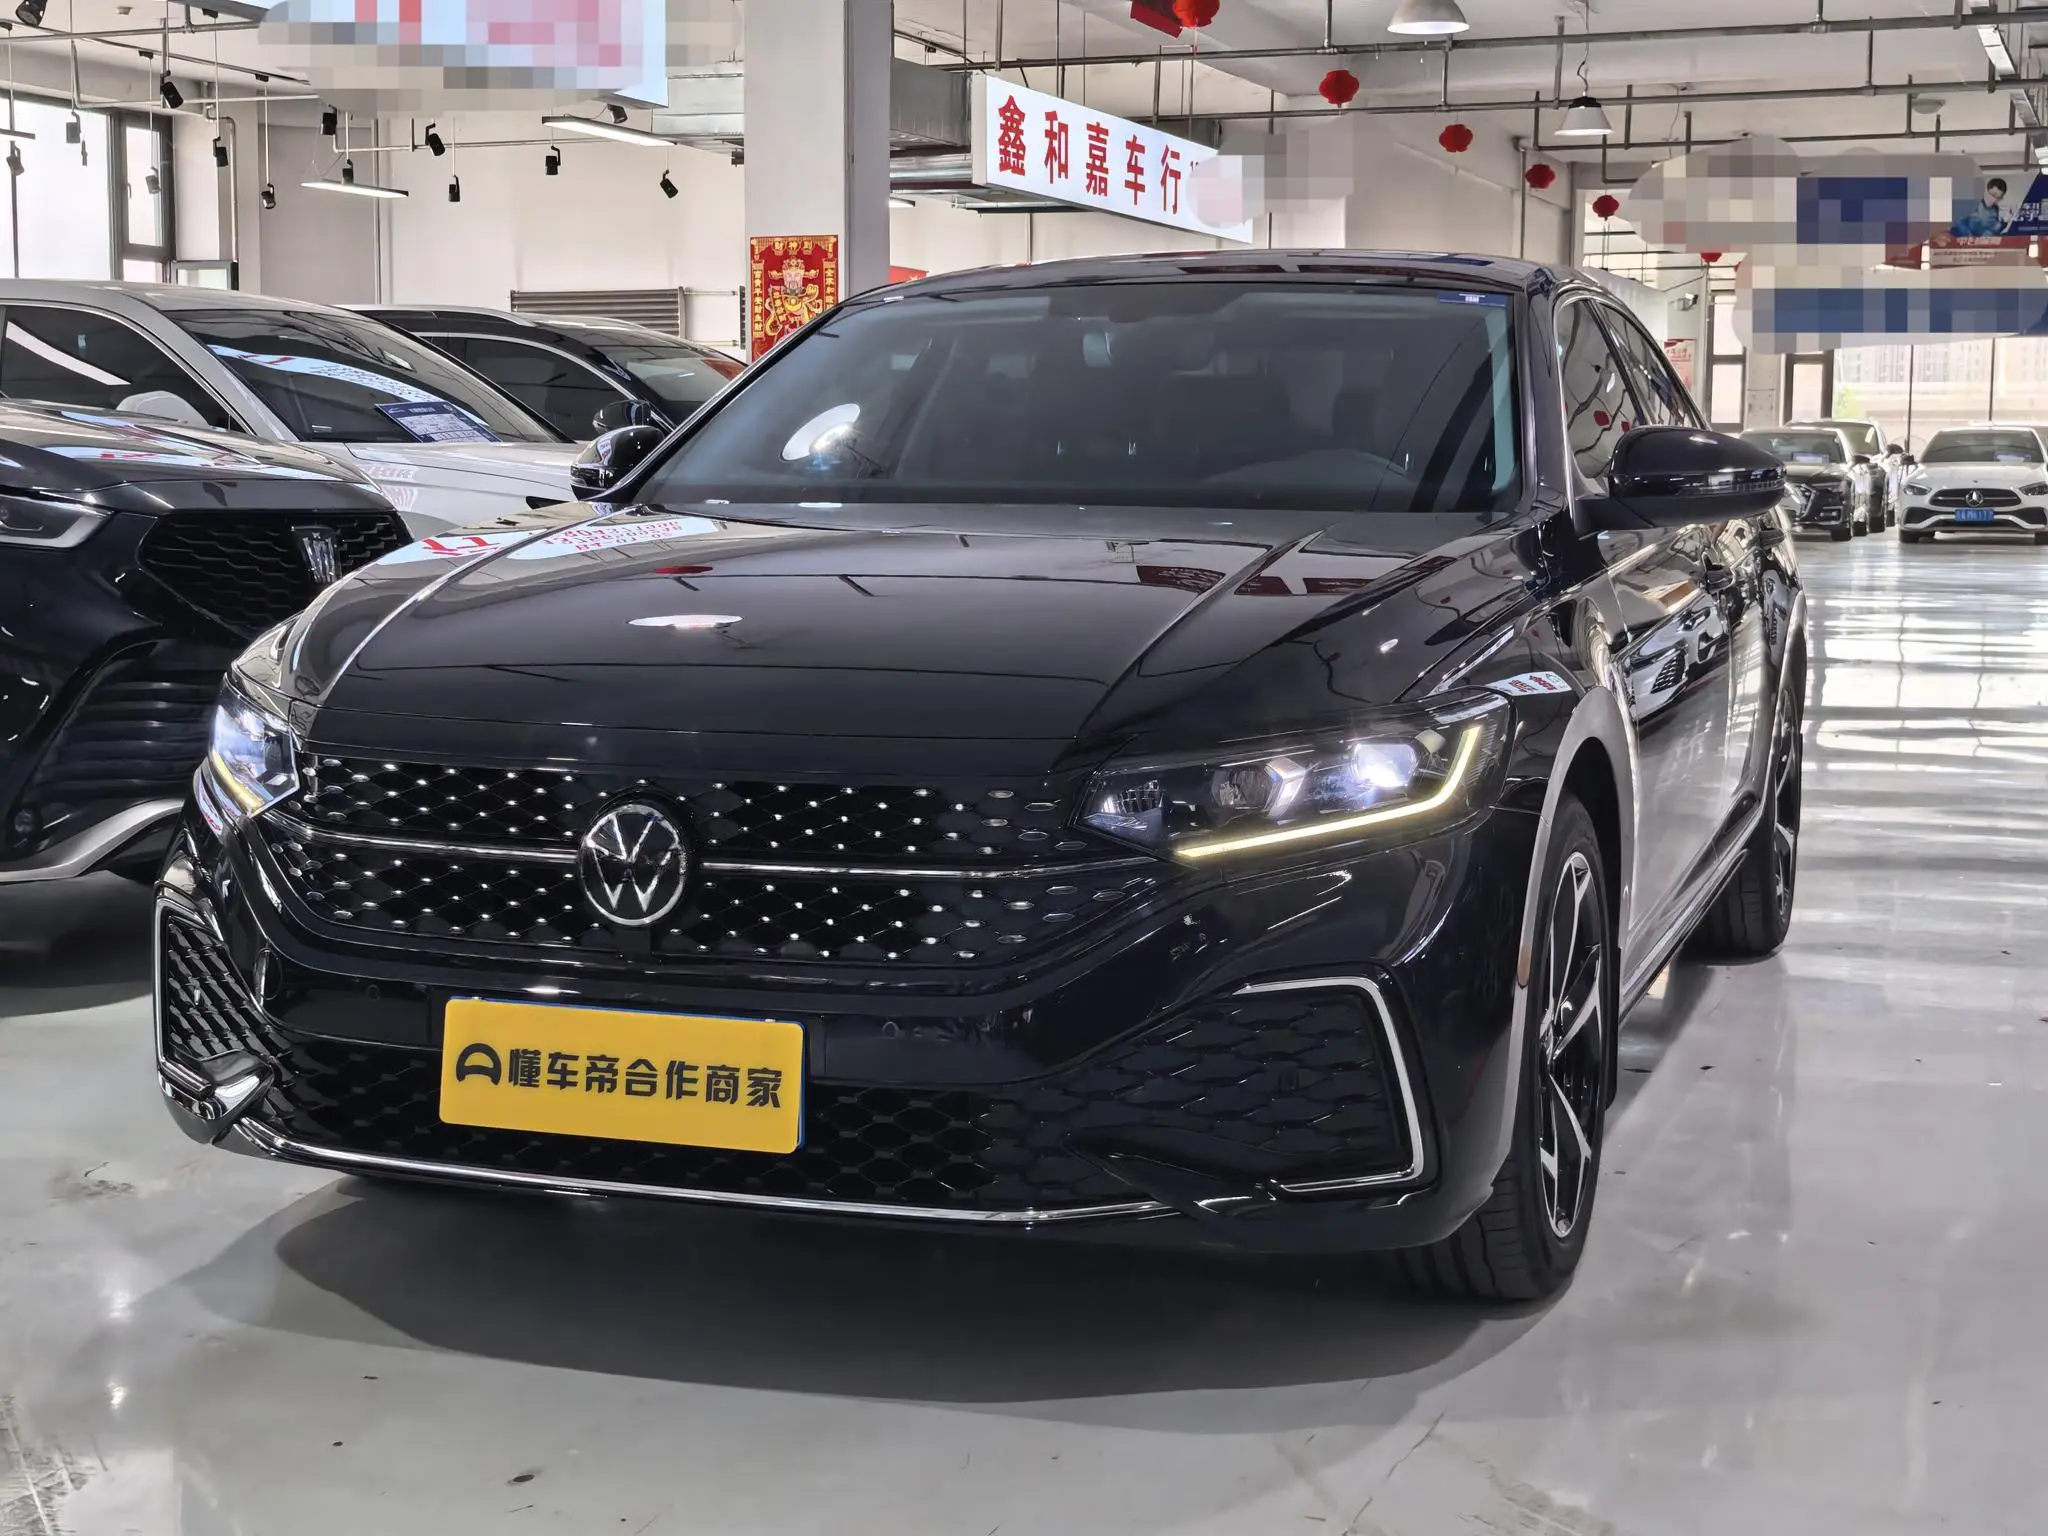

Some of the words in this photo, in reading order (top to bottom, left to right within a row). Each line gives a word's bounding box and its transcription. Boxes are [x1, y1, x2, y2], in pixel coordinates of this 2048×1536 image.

[997, 94, 1182, 216] 鑫和嘉车行
[507, 1048, 783, 1109] 懂车帝合作商家
